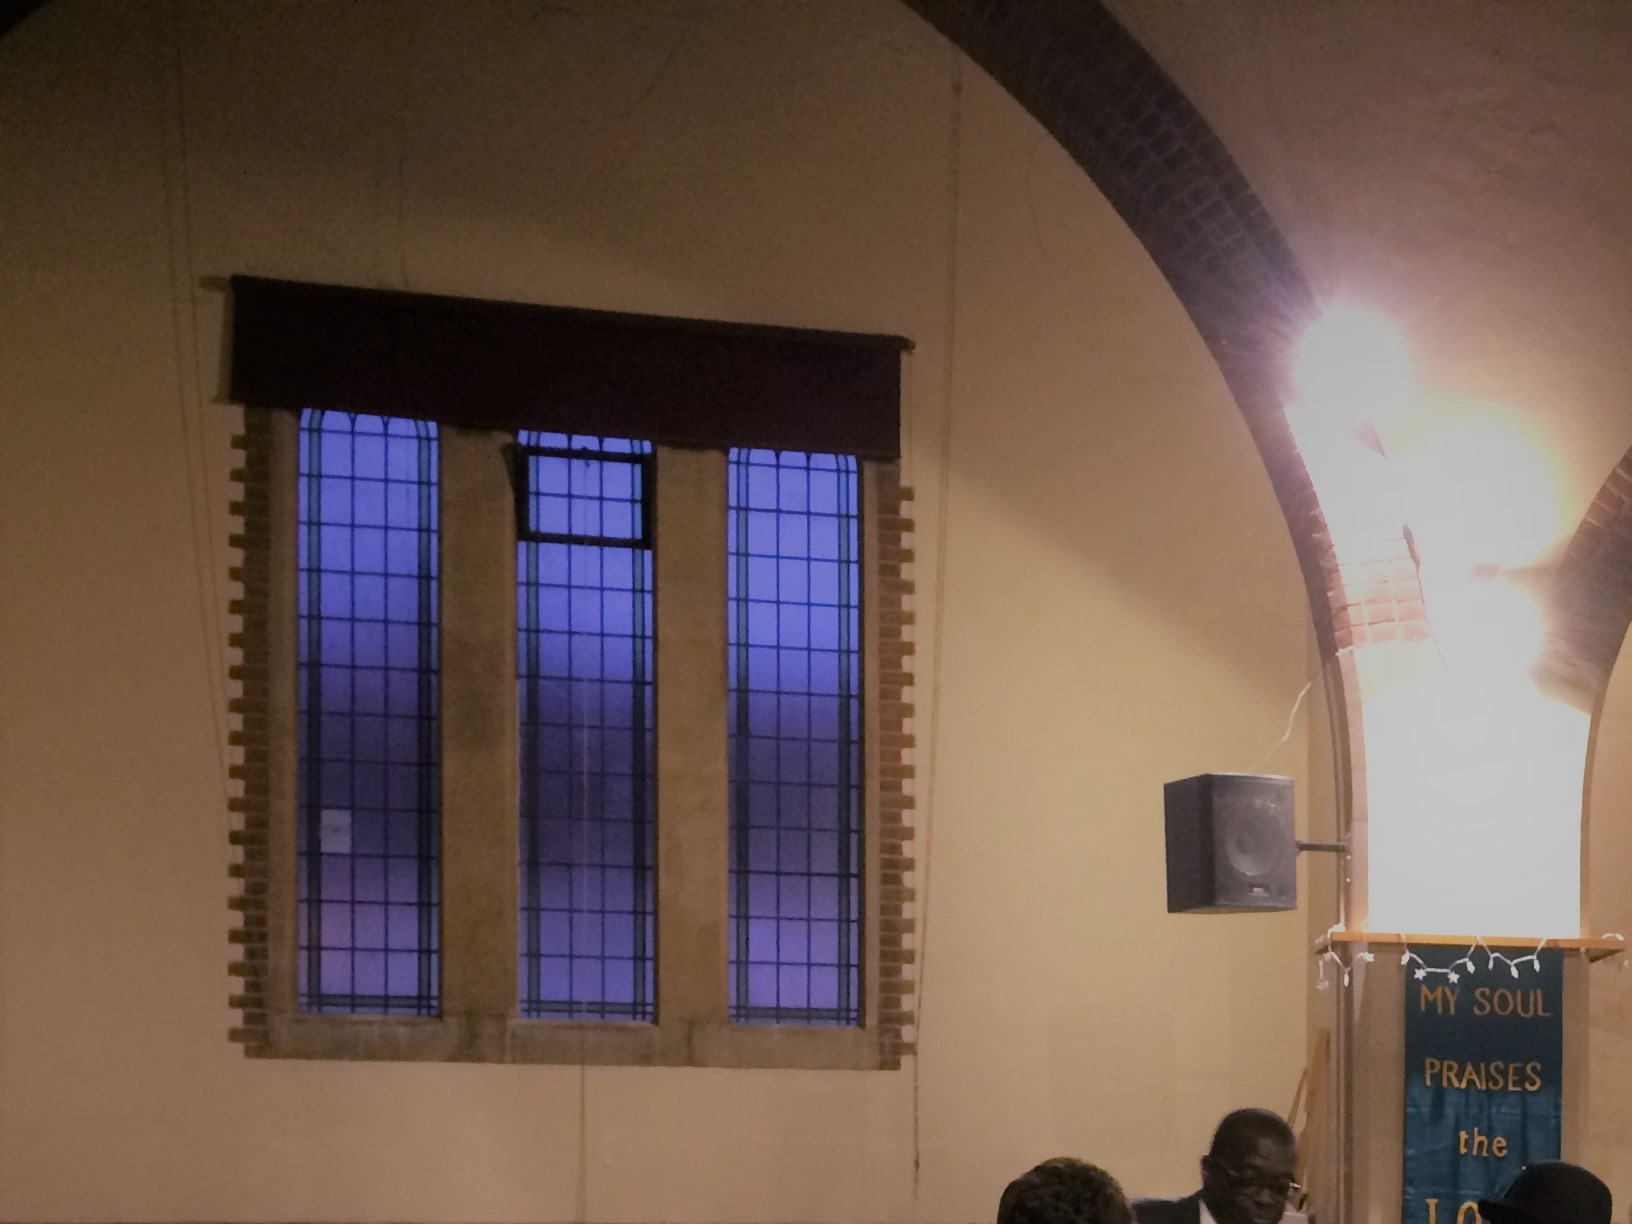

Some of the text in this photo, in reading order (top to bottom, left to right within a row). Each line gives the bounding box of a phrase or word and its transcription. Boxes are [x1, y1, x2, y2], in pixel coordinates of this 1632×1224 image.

[1419, 984, 1550, 1018] MY SOUL
[1424, 1057, 1542, 1092] PRAISES
[1459, 1127, 1508, 1157] the
